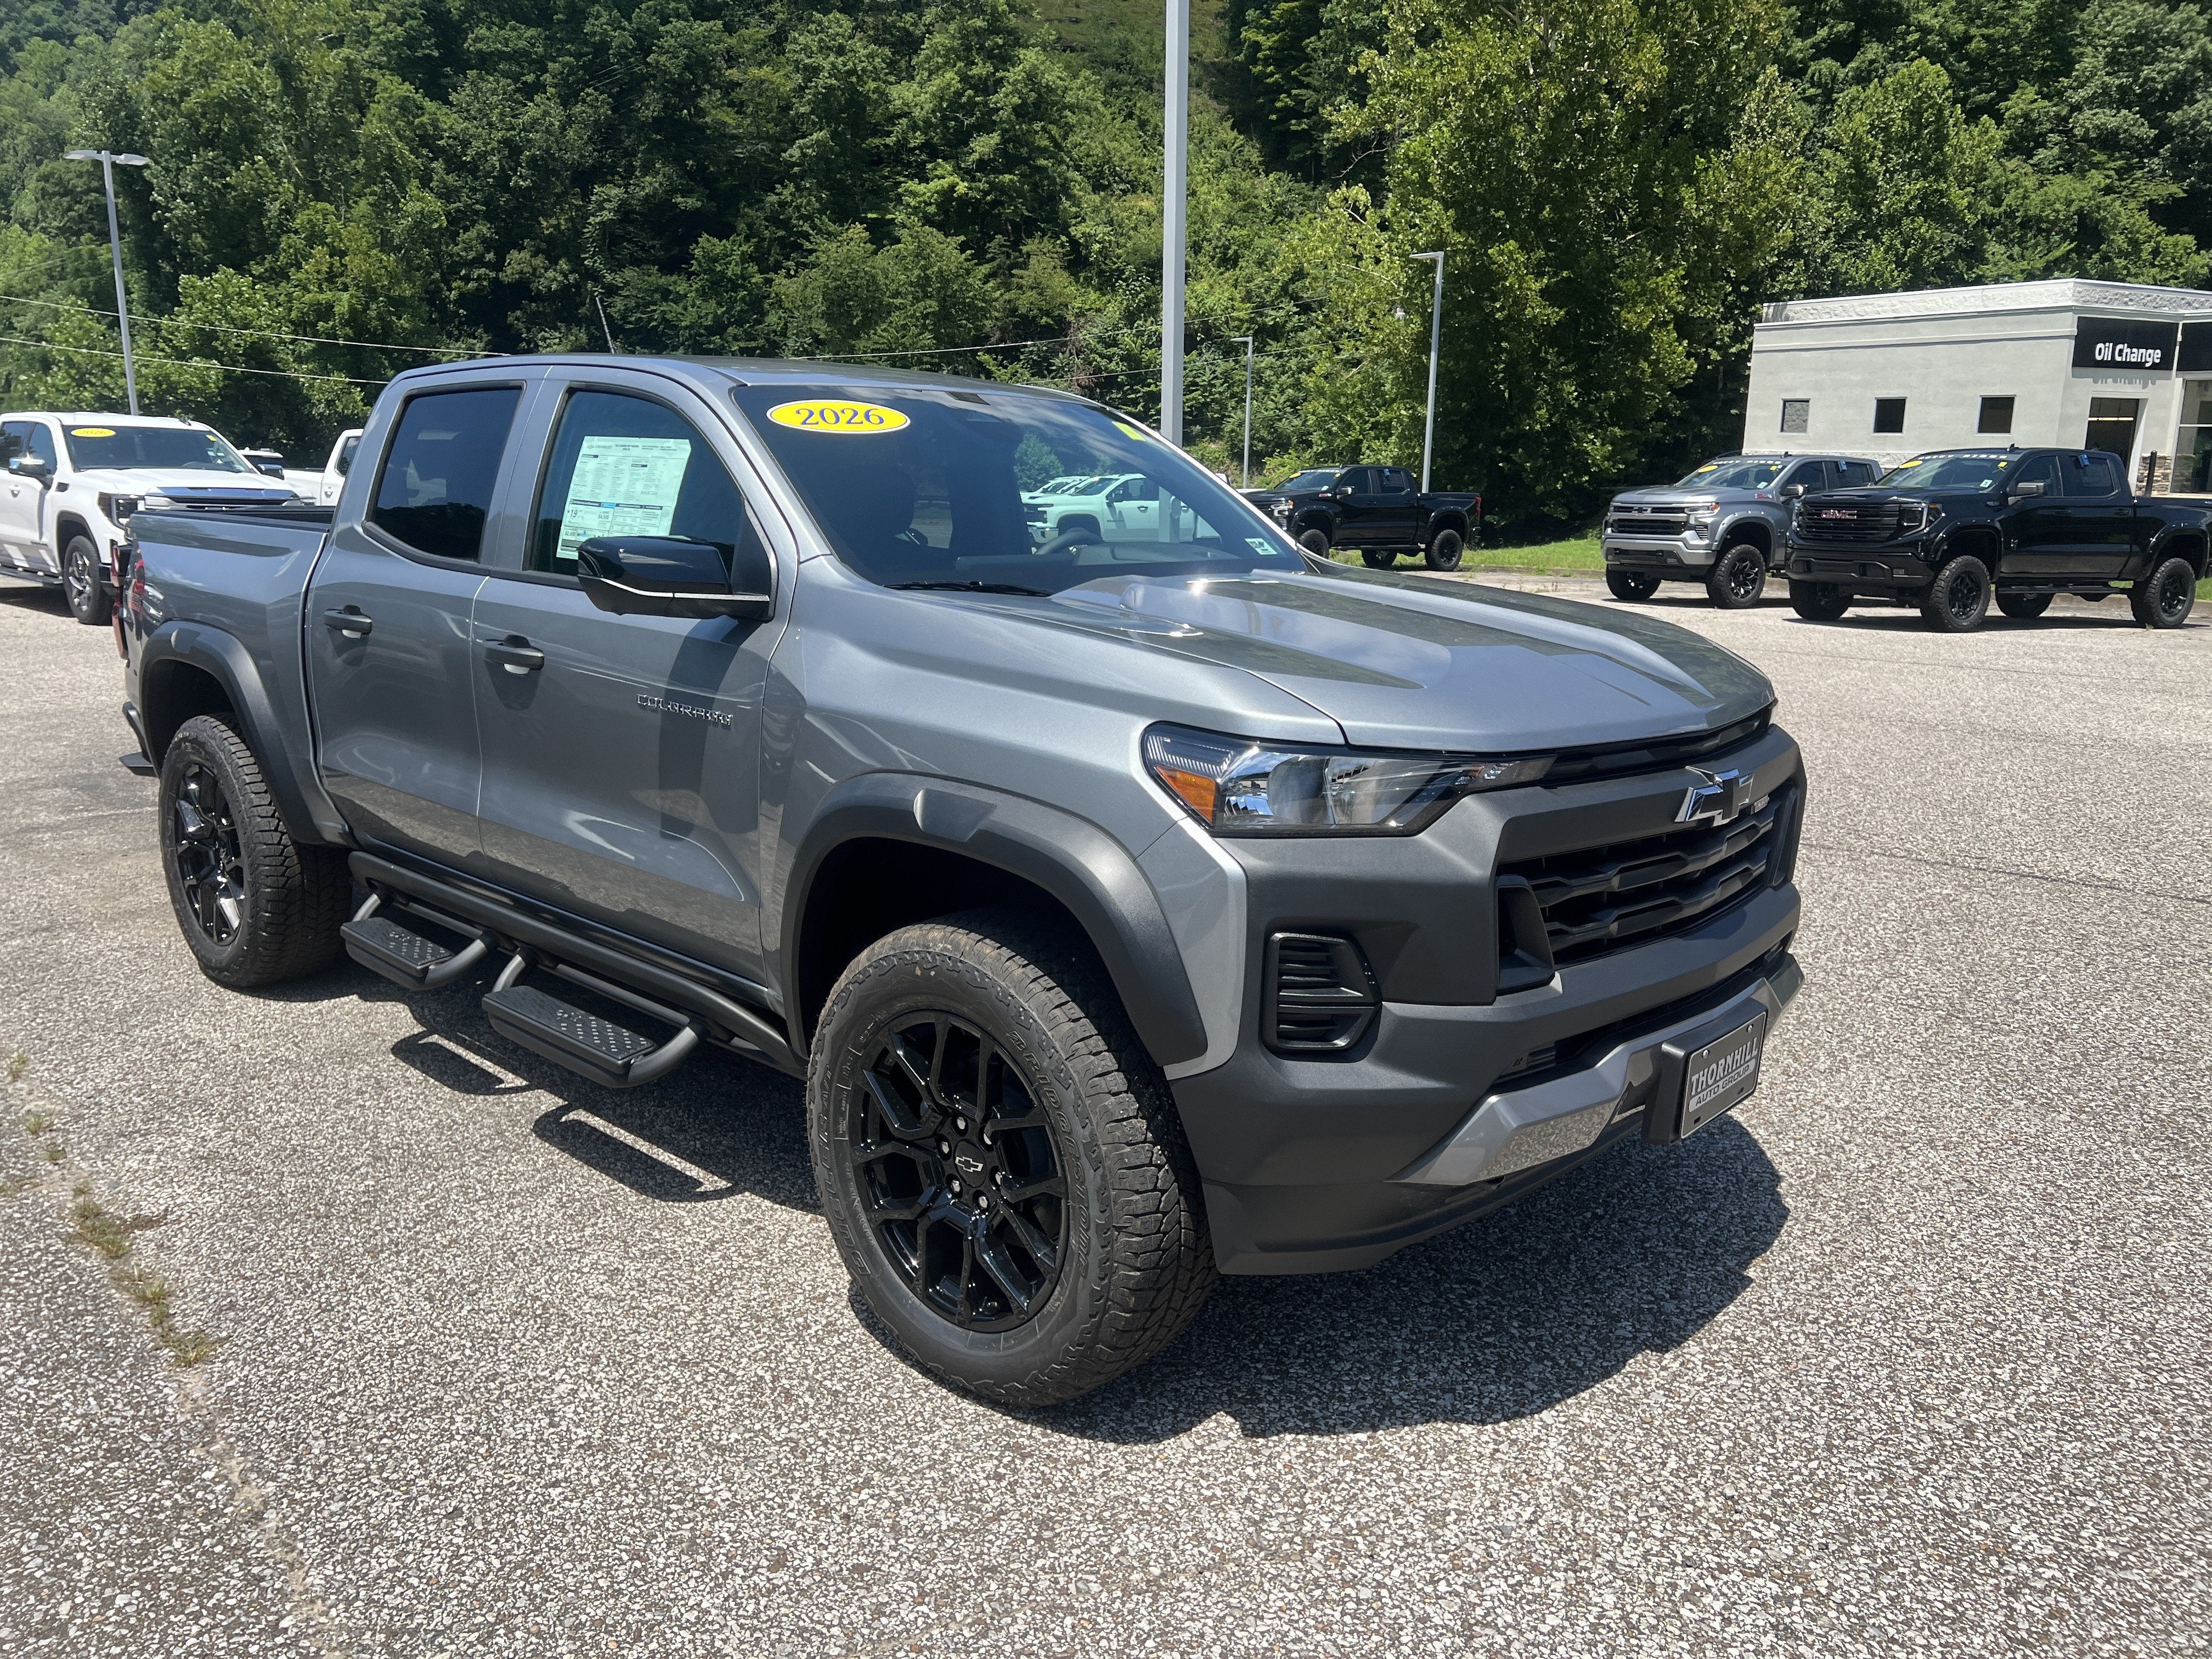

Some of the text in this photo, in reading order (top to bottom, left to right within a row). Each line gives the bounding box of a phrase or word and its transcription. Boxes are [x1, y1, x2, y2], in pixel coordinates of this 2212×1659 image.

[2095, 342, 2161, 367] Oil Change
[795, 408, 884, 425] 2026
[571, 509, 578, 518] 19
[1821, 509, 1857, 519] GMC
[636, 693, 733, 726] COLORADO
[1690, 1037, 1758, 1096] THORNHILL
[1696, 1064, 1750, 1107] AUTO GROUP
[1006, 1030, 1091, 1279] BRIDGESTONE
